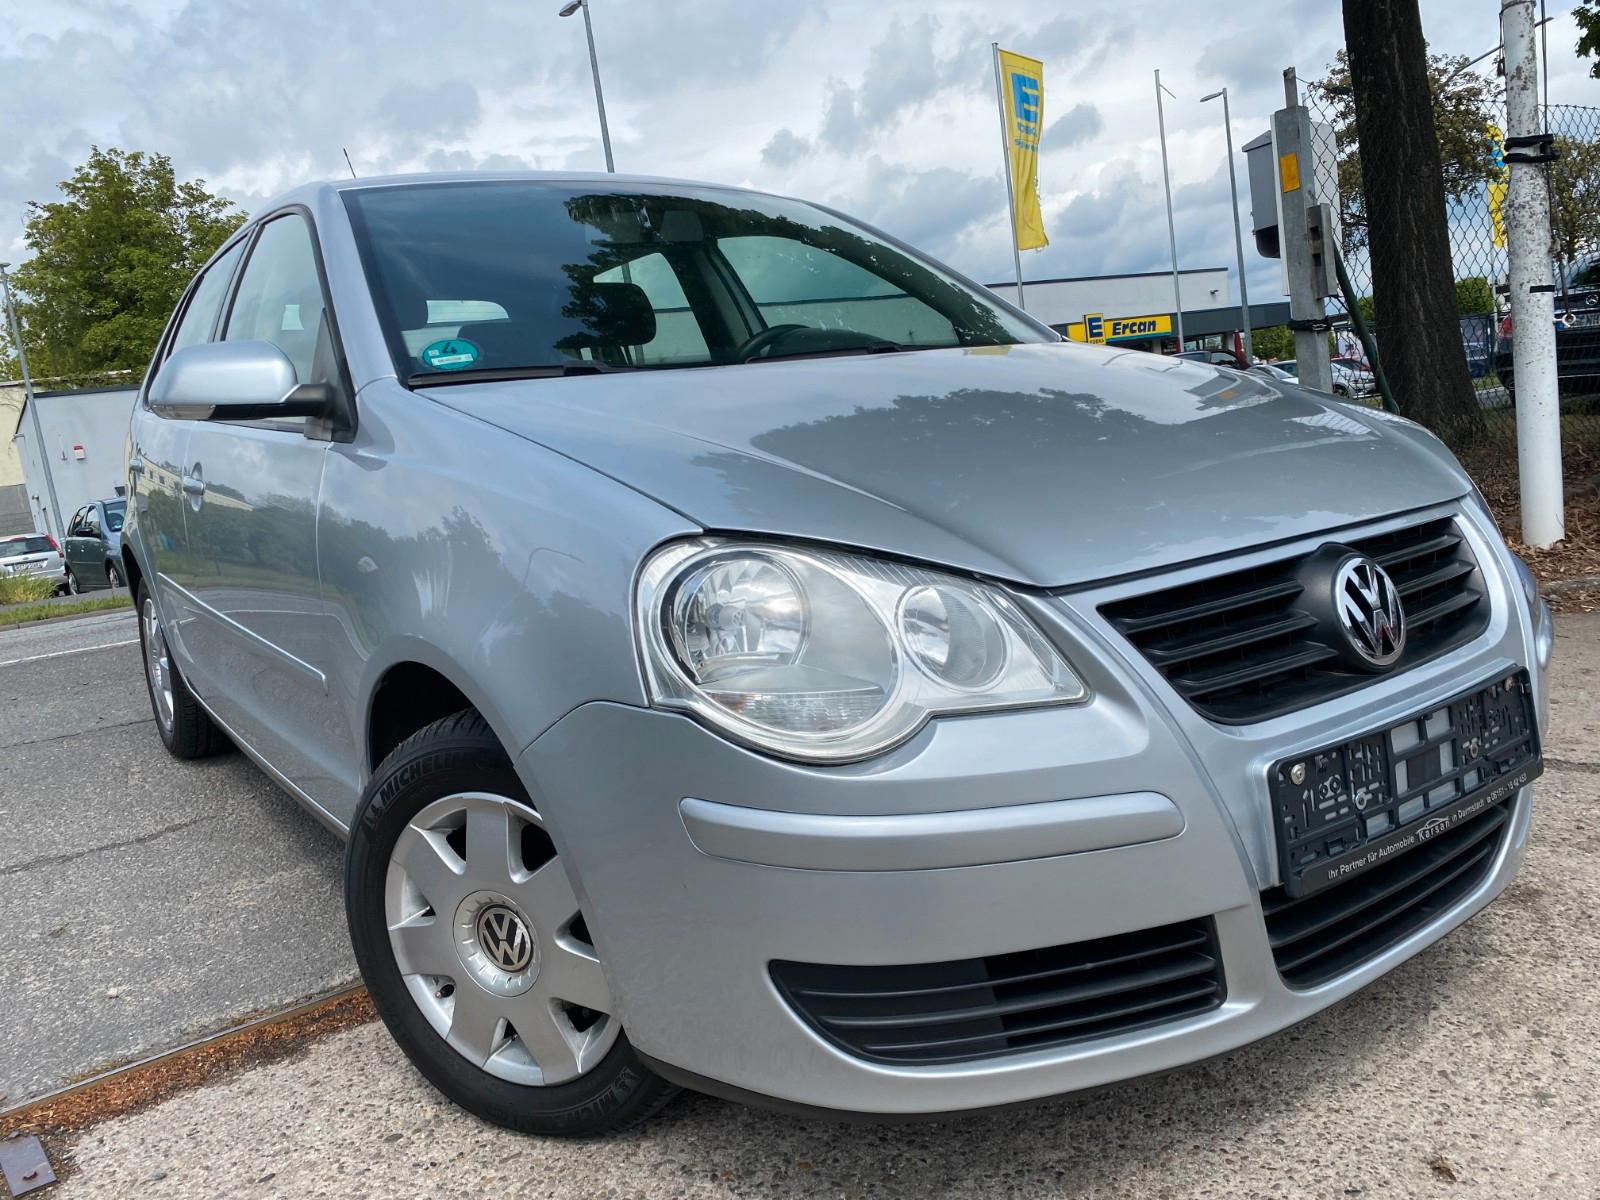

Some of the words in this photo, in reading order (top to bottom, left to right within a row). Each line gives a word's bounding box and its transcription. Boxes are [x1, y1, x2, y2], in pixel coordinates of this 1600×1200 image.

[442, 342, 457, 354] 4
[1088, 317, 1103, 338] E
[1112, 320, 1157, 336] Ercan
[1335, 557, 1406, 666] VW
[1328, 868, 1339, 880] Ihr
[1339, 857, 1367, 875] Partner
[1367, 850, 1378, 863] für
[1379, 835, 1415, 858] Automobile
[1418, 819, 1450, 841] Karsan
[1451, 815, 1458, 823] in
[1458, 799, 1485, 819] Darmstadt
[477, 905, 533, 972] VW
